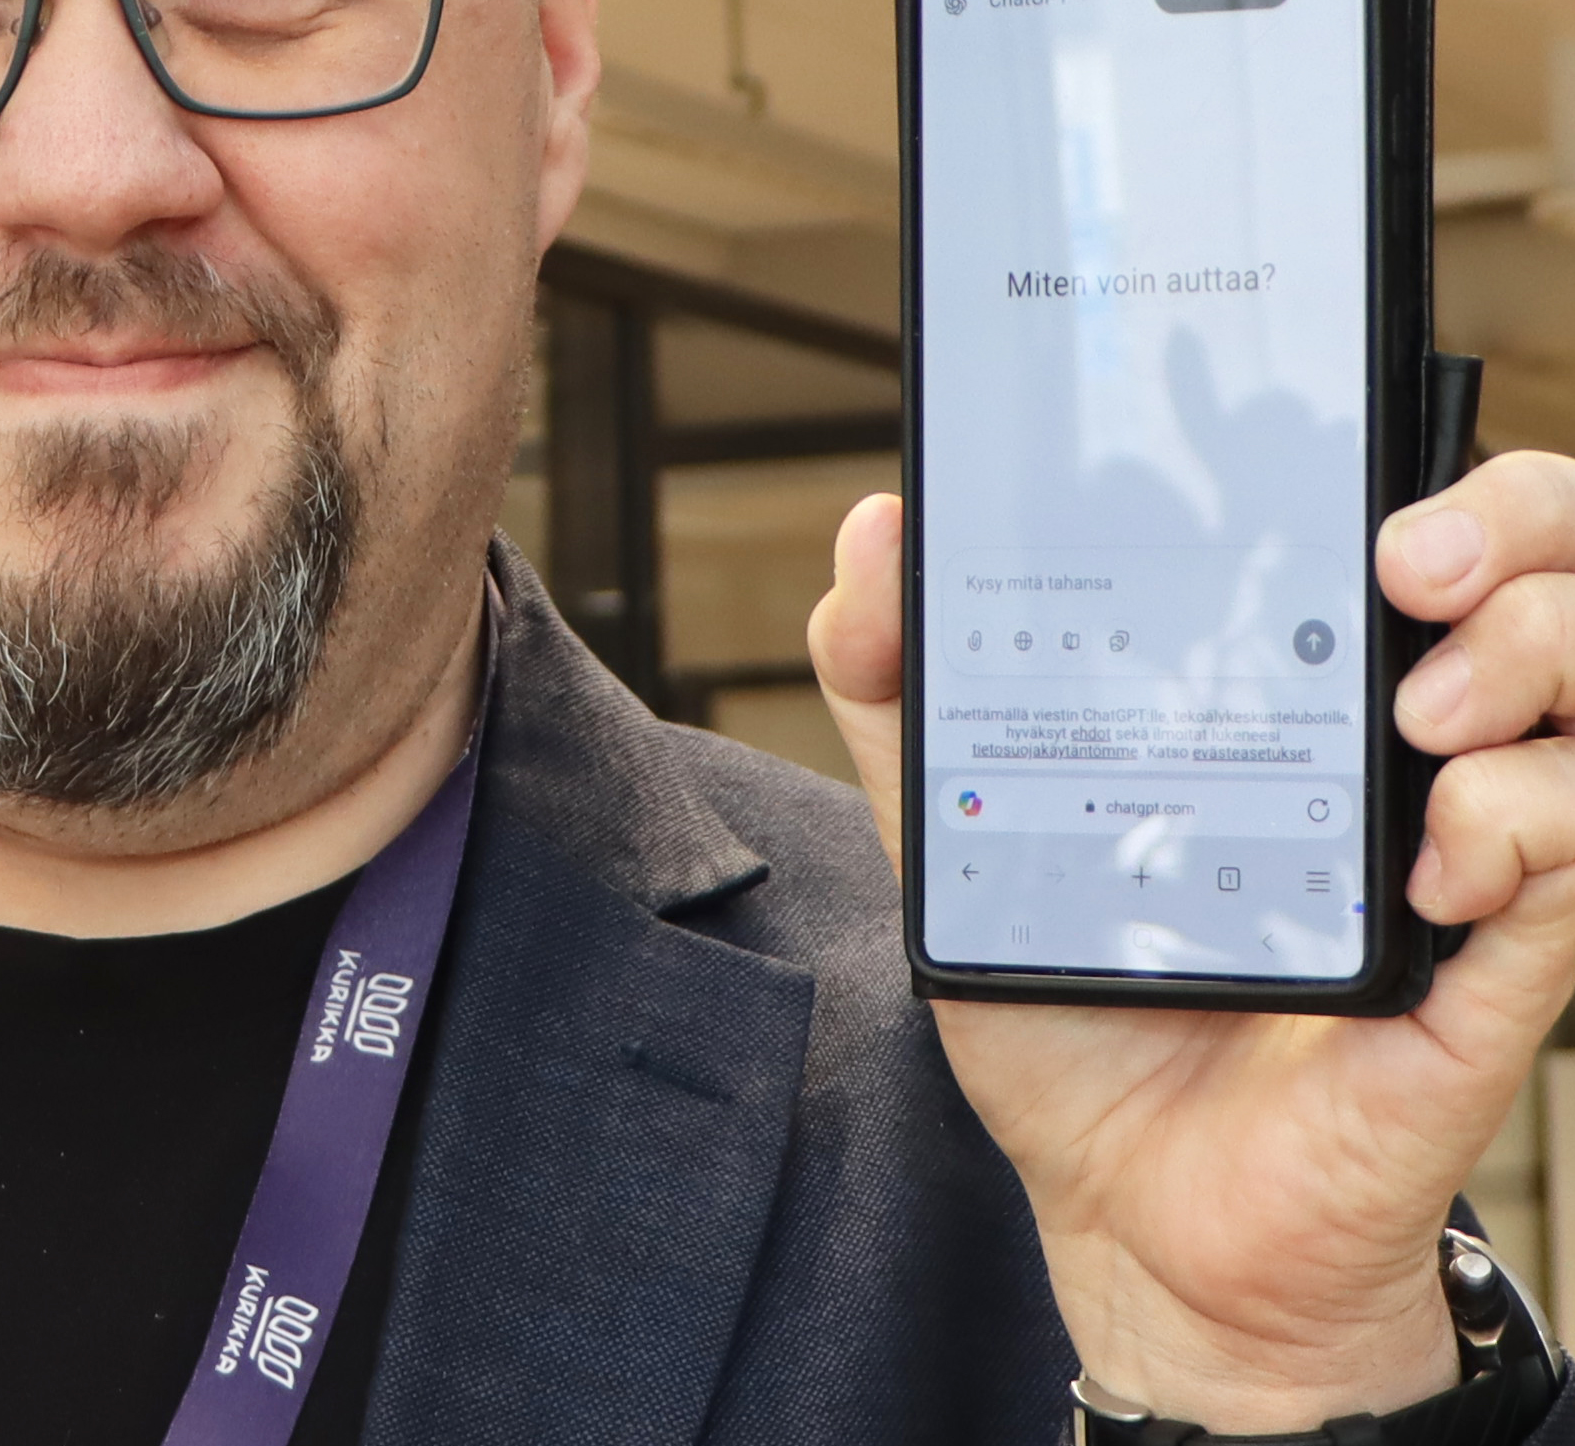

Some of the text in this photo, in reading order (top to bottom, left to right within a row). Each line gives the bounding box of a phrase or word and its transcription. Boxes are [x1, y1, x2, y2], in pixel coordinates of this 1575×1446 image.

[1007, 262, 1276, 298] Miten voin auttaa?
[965, 573, 1113, 595] Kysy mitä tahansa
[1032, 707, 1080, 722] viestin
[1005, 724, 1067, 741] hyväksyt
[1070, 725, 1112, 742] ehdot
[1115, 726, 1149, 741] sekä
[1146, 745, 1188, 760] Katso
[1105, 800, 1196, 818] chatgpt.com
[310, 949, 361, 1063] KURIKKA
[215, 1263, 270, 1375] KURIKKA
